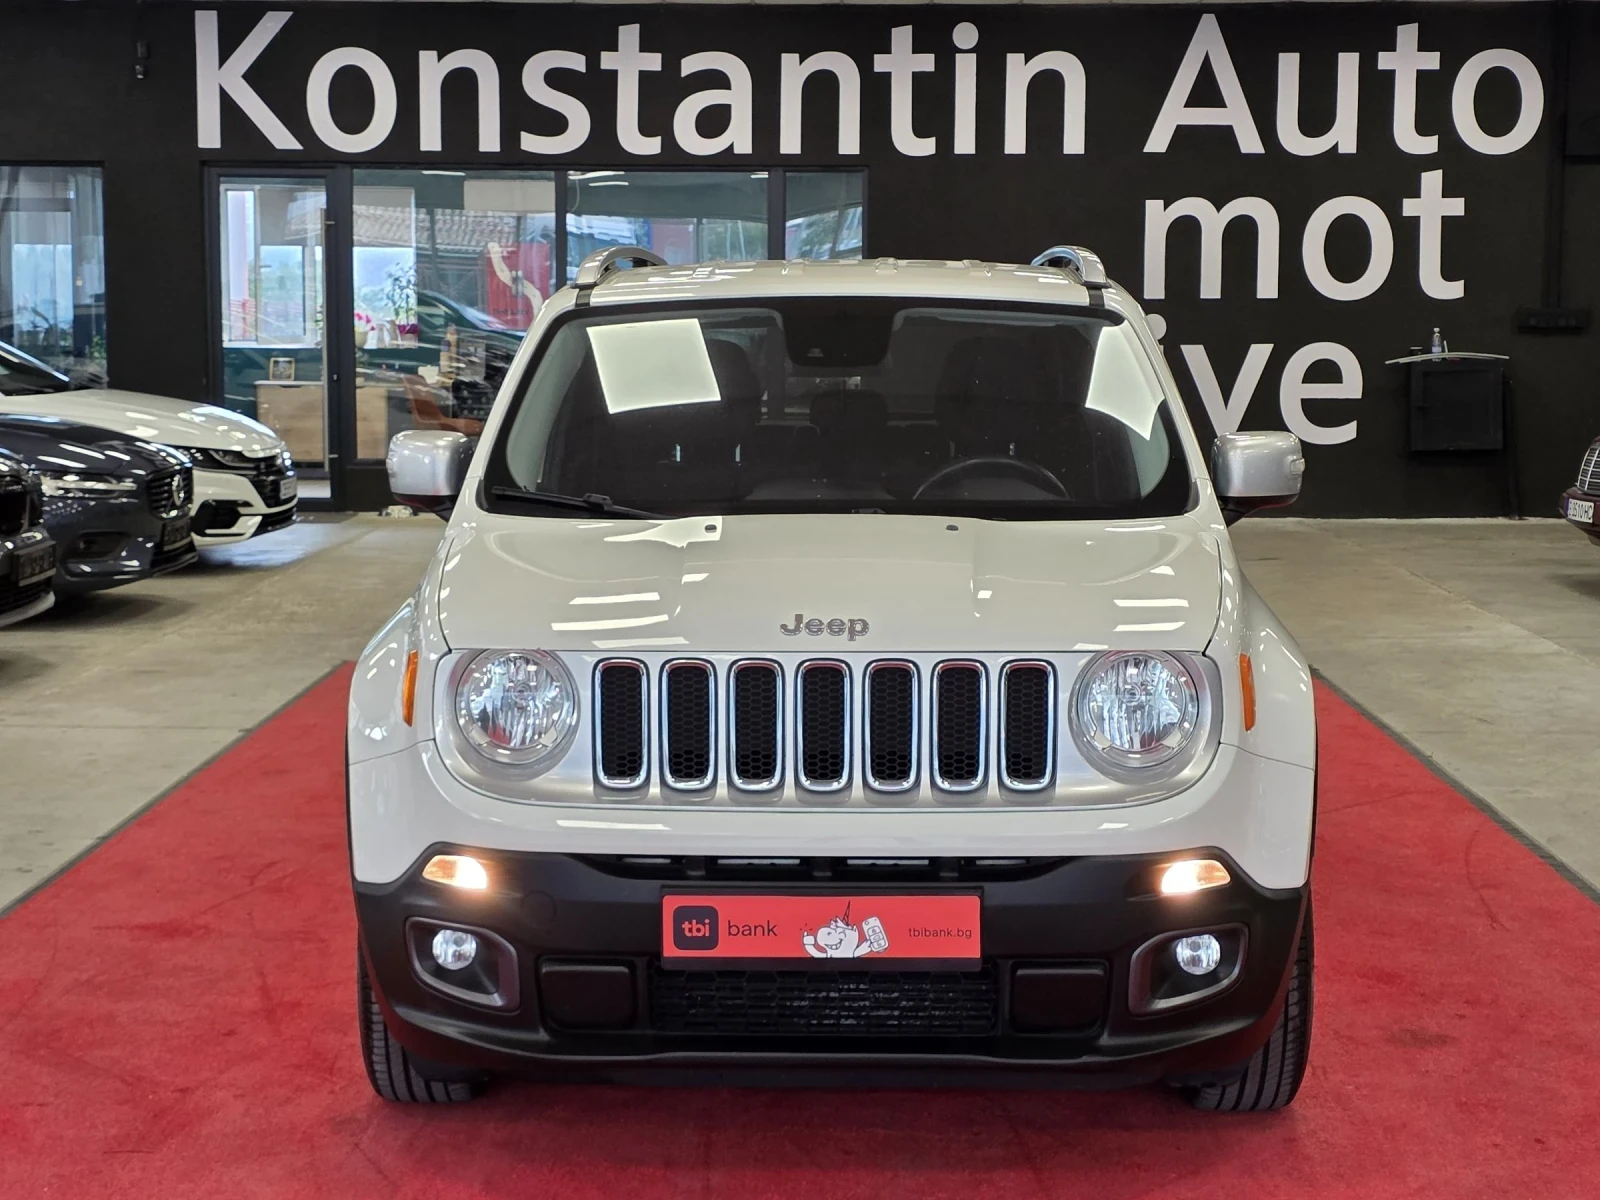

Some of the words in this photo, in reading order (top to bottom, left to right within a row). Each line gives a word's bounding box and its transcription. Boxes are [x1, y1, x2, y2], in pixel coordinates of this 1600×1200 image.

[195, 11, 1086, 156] Konstantin
[1143, 14, 1544, 156] Auto
[1143, 169, 1464, 301] mot
[1146, 313, 1363, 445] ve
[780, 613, 869, 641] Jeep
[682, 919, 710, 937] tbi
[727, 919, 778, 937] bank
[908, 927, 972, 940] tbibank.bg
